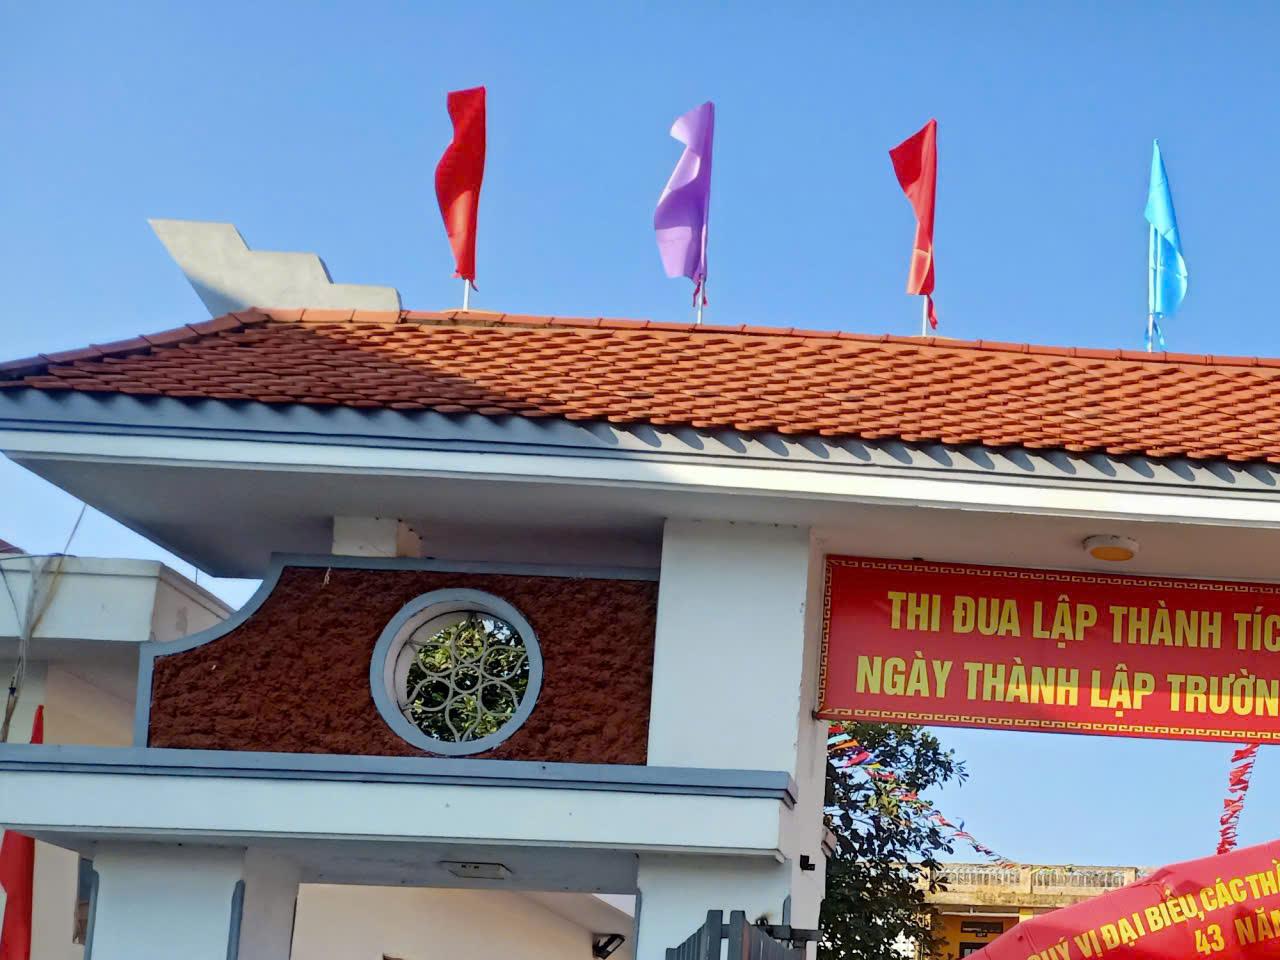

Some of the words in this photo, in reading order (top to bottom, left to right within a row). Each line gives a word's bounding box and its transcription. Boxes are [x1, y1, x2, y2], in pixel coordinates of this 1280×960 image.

[888, 591, 940, 631] THI
[953, 596, 1020, 637] ĐUA
[1032, 594, 1098, 649] LẬP
[1109, 600, 1222, 649] THÀNH
[856, 650, 953, 698] NGÀY
[963, 657, 1079, 703] THÀNH
[1090, 664, 1155, 718] LẬP
[1073, 930, 1102, 957] VỊ
[1101, 913, 1145, 950] ĐẠI
[1144, 888, 1204, 931] BIỂU,
[1200, 877, 1247, 911] CÁC
[1194, 924, 1225, 956] 43
